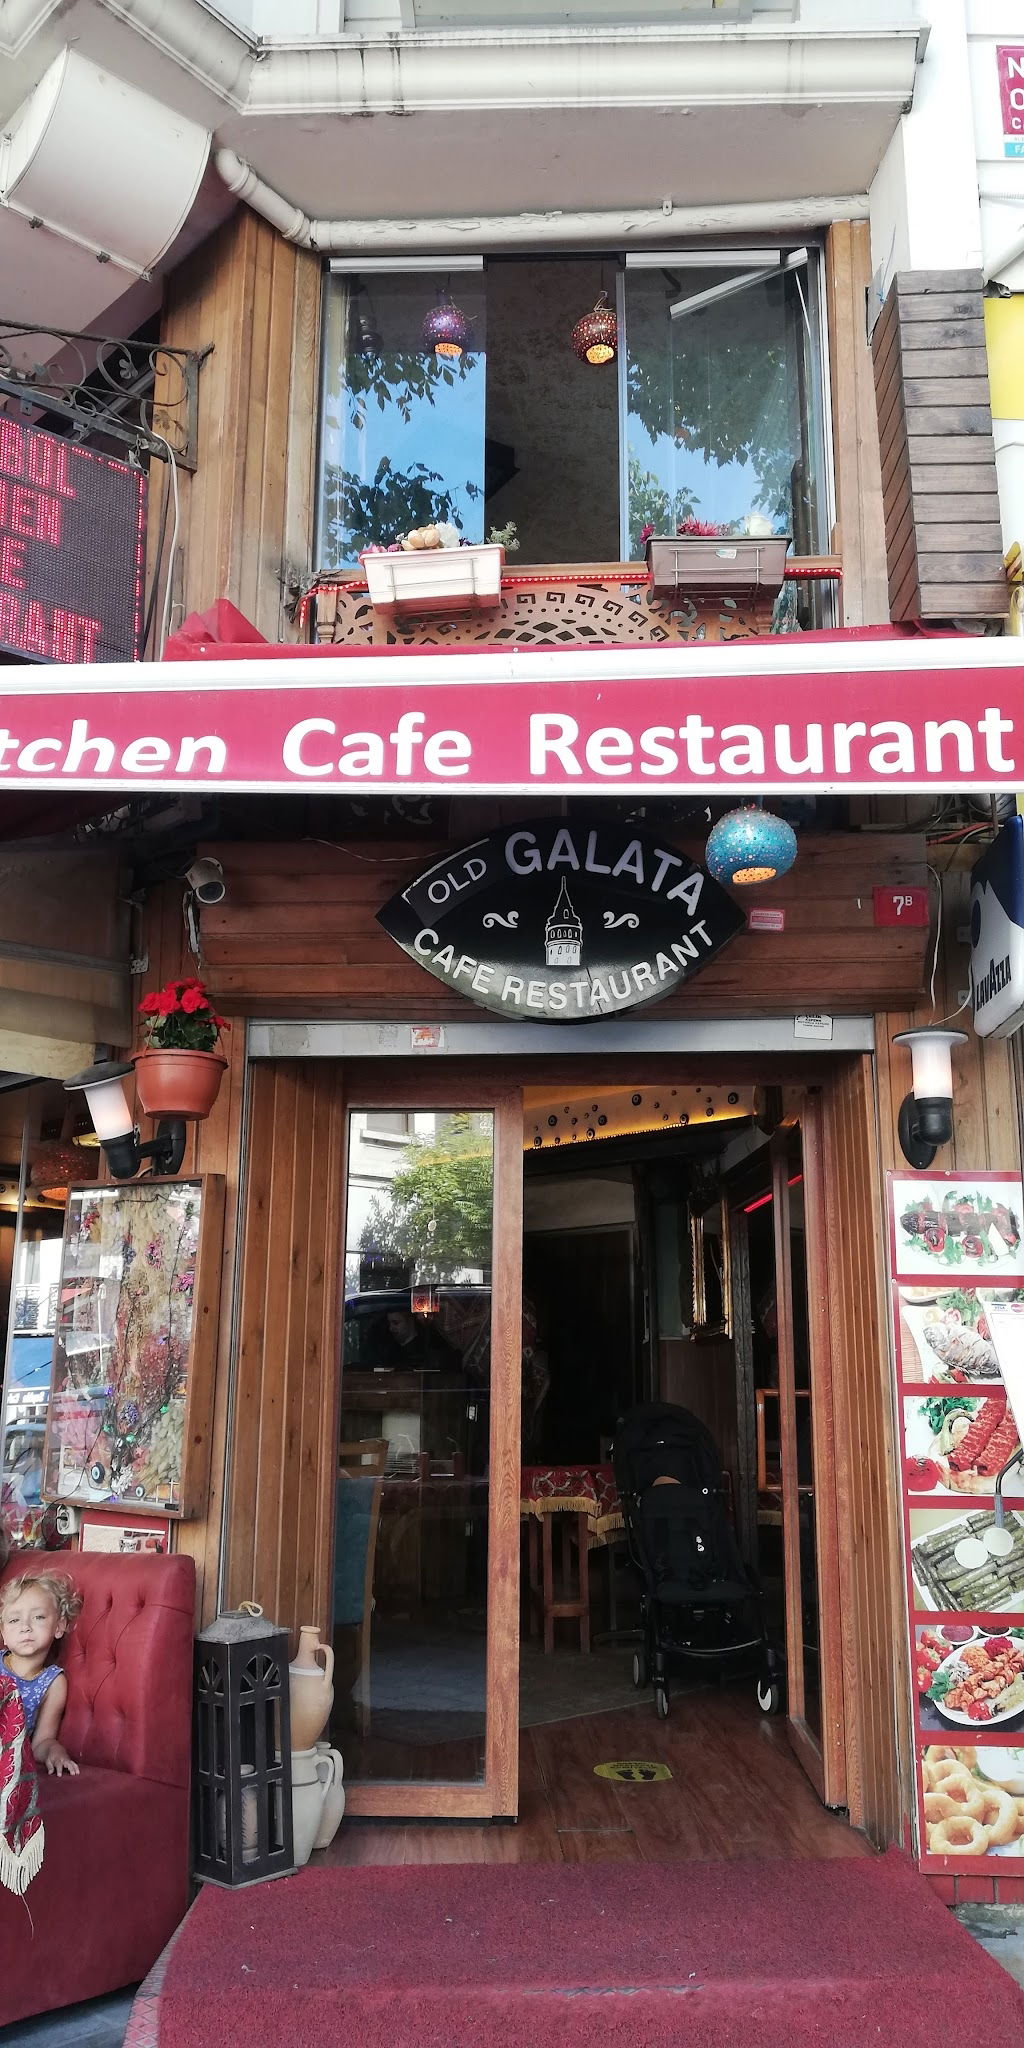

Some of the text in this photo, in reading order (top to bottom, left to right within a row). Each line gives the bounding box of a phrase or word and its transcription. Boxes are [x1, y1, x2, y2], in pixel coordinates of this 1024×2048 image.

[282, 712, 472, 776] Cafe
[529, 708, 1015, 775] Restaurant
[427, 829, 705, 916] OLD GALATA
[414, 919, 713, 1010] CAFE RESTAURANT
[976, 954, 1012, 1012] LAVAZZA
